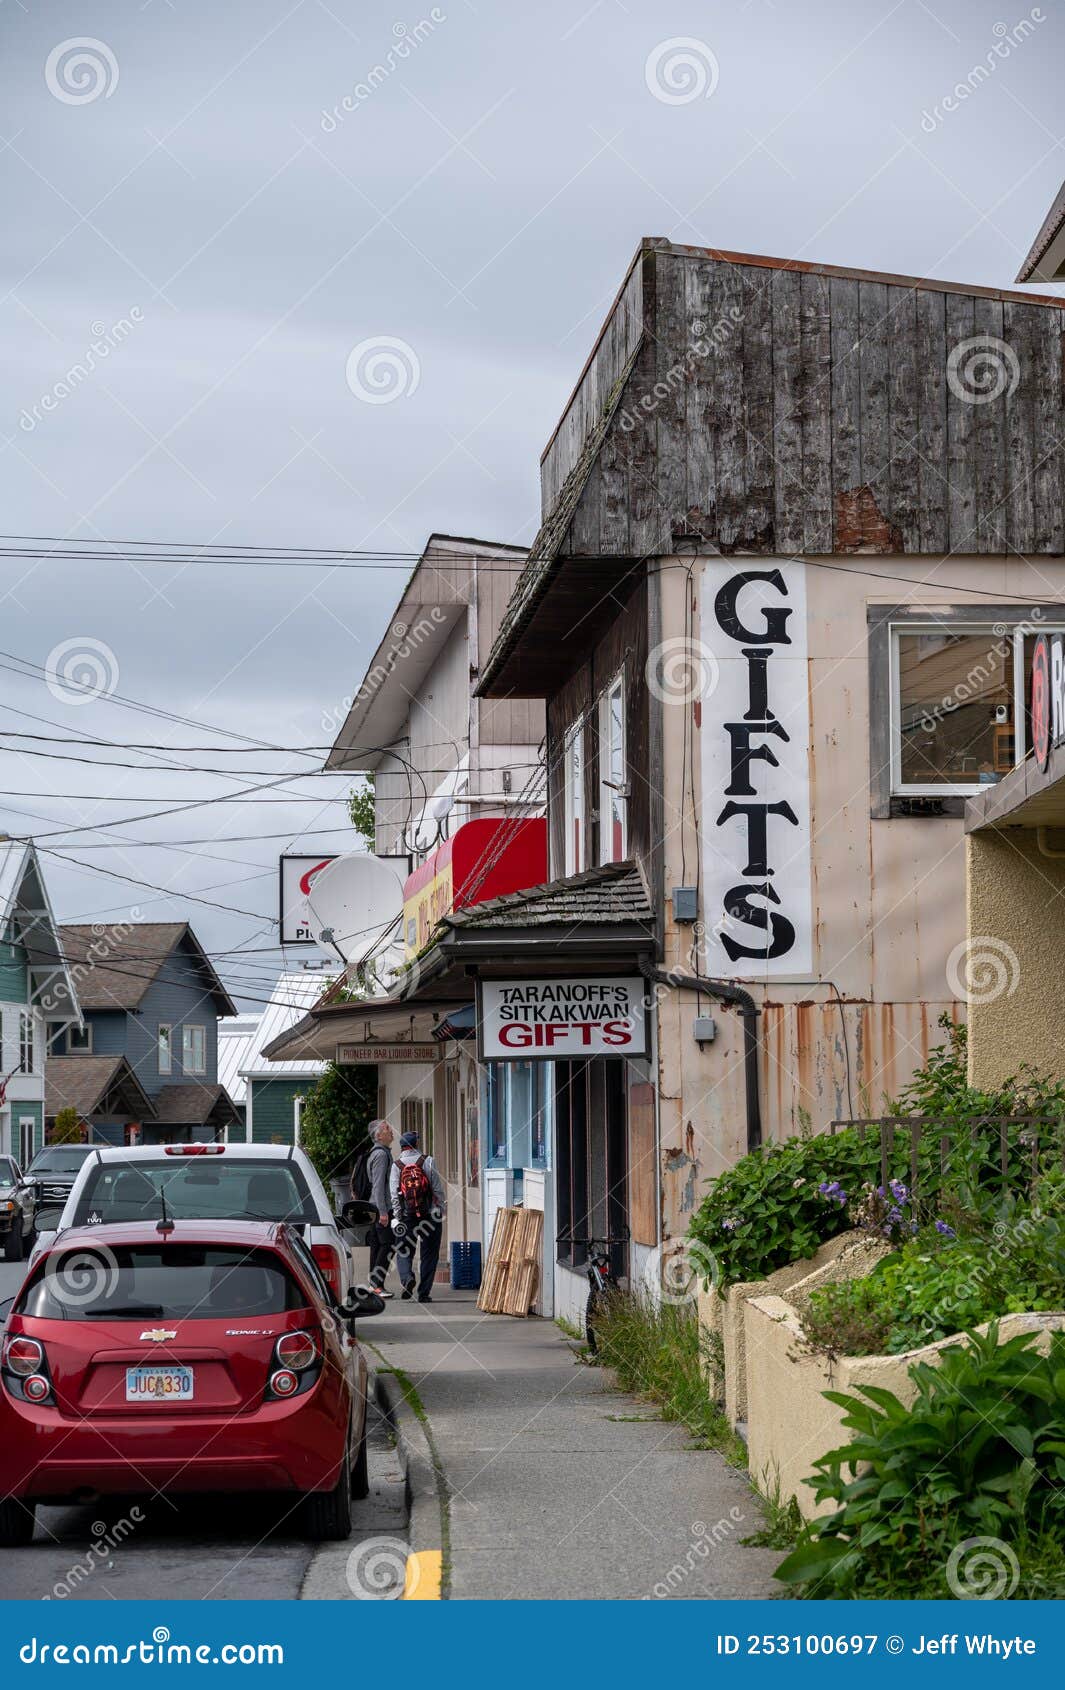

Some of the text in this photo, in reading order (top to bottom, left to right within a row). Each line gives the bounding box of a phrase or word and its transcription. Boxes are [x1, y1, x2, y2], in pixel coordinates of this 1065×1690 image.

[714, 568, 799, 962] GIFTS
[499, 984, 629, 1004] TARANOFF'S
[499, 1003, 629, 1022] SITKAKWAN
[498, 1021, 632, 1048] GIFTS
